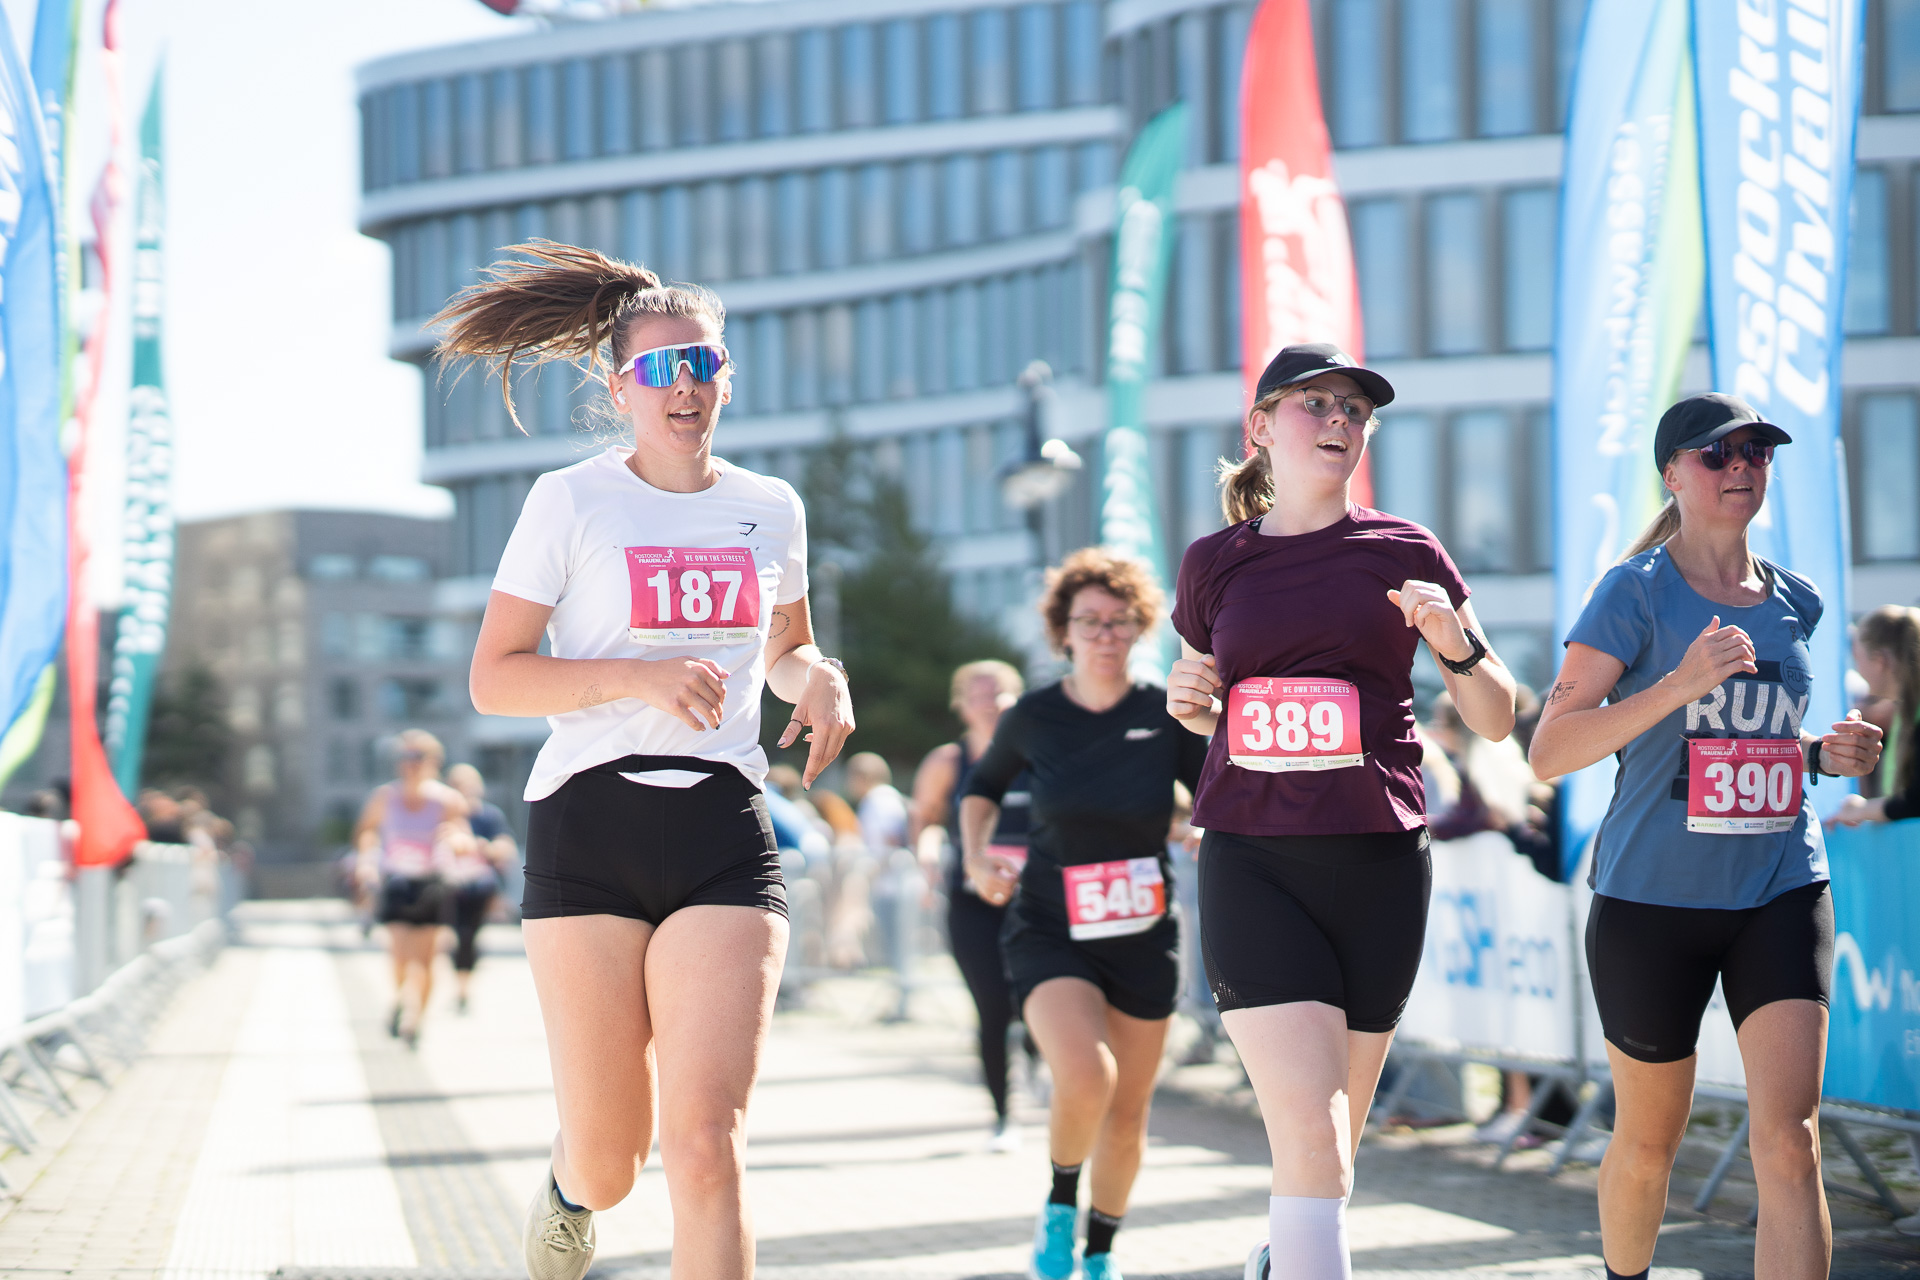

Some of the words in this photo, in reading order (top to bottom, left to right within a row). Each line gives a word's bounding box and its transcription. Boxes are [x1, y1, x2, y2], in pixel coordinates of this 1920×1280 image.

[1774, 0, 1832, 417] Citylau
[722, 555, 746, 563] STREETS
[647, 570, 743, 622] 187
[1323, 686, 1350, 694] STREETS
[1686, 681, 1809, 737] RUN
[1241, 700, 1344, 752] 389
[1746, 747, 1755, 755] WE
[1703, 762, 1793, 812] 390
[1076, 878, 1156, 922] 546
